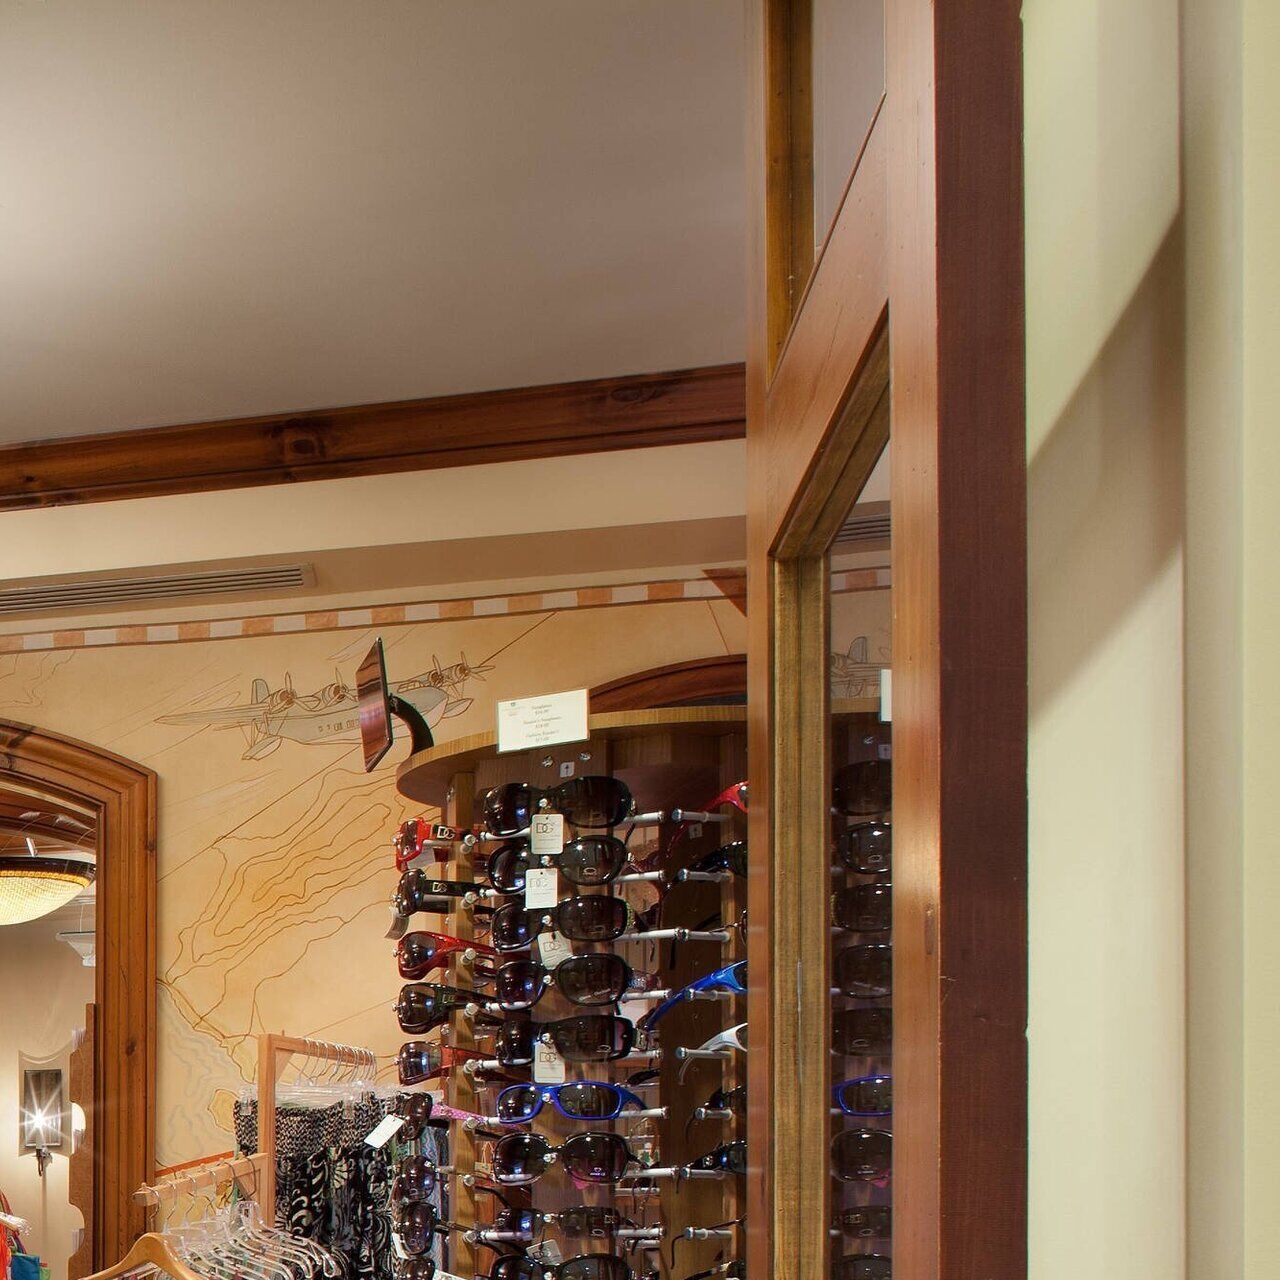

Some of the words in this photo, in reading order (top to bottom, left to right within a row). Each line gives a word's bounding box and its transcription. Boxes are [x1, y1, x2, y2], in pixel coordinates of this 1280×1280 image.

[437, 825, 456, 839] DG
[536, 822, 554, 834] DG
[539, 1051, 557, 1063] DG
